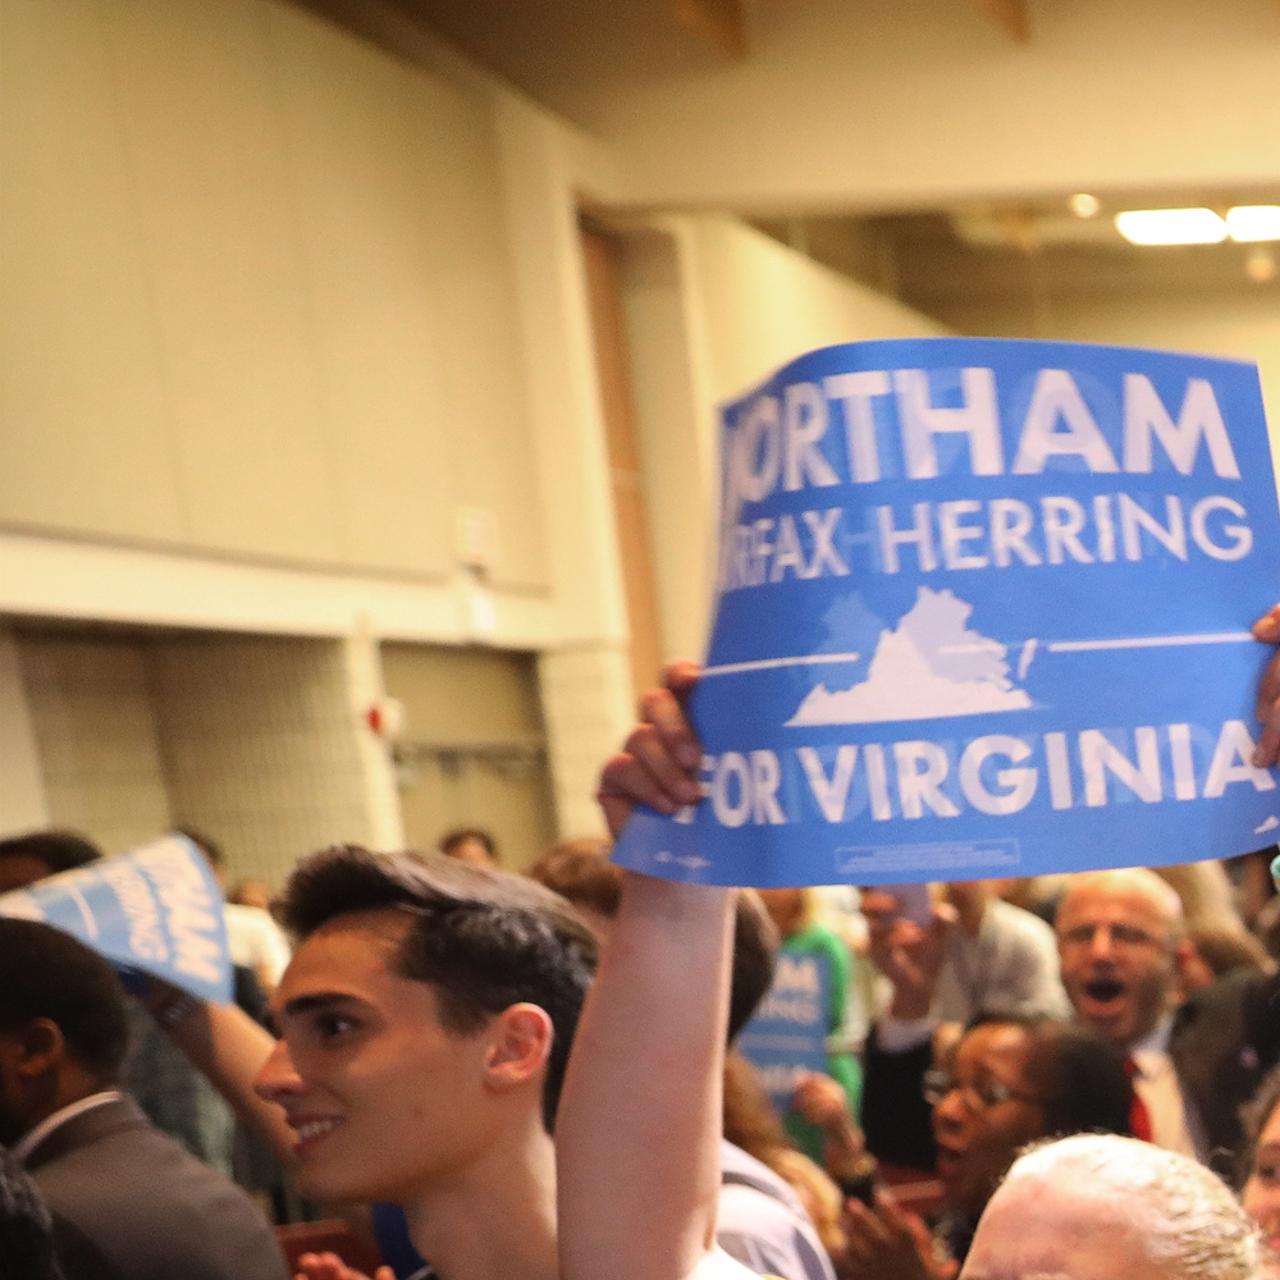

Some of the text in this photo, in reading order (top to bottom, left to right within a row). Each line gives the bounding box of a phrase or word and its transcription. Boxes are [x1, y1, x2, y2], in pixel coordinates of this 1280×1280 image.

[720, 366, 1242, 502] ORTHAM
[881, 492, 1253, 574] HERRING
[800, 719, 1278, 825] VIRGINIA
